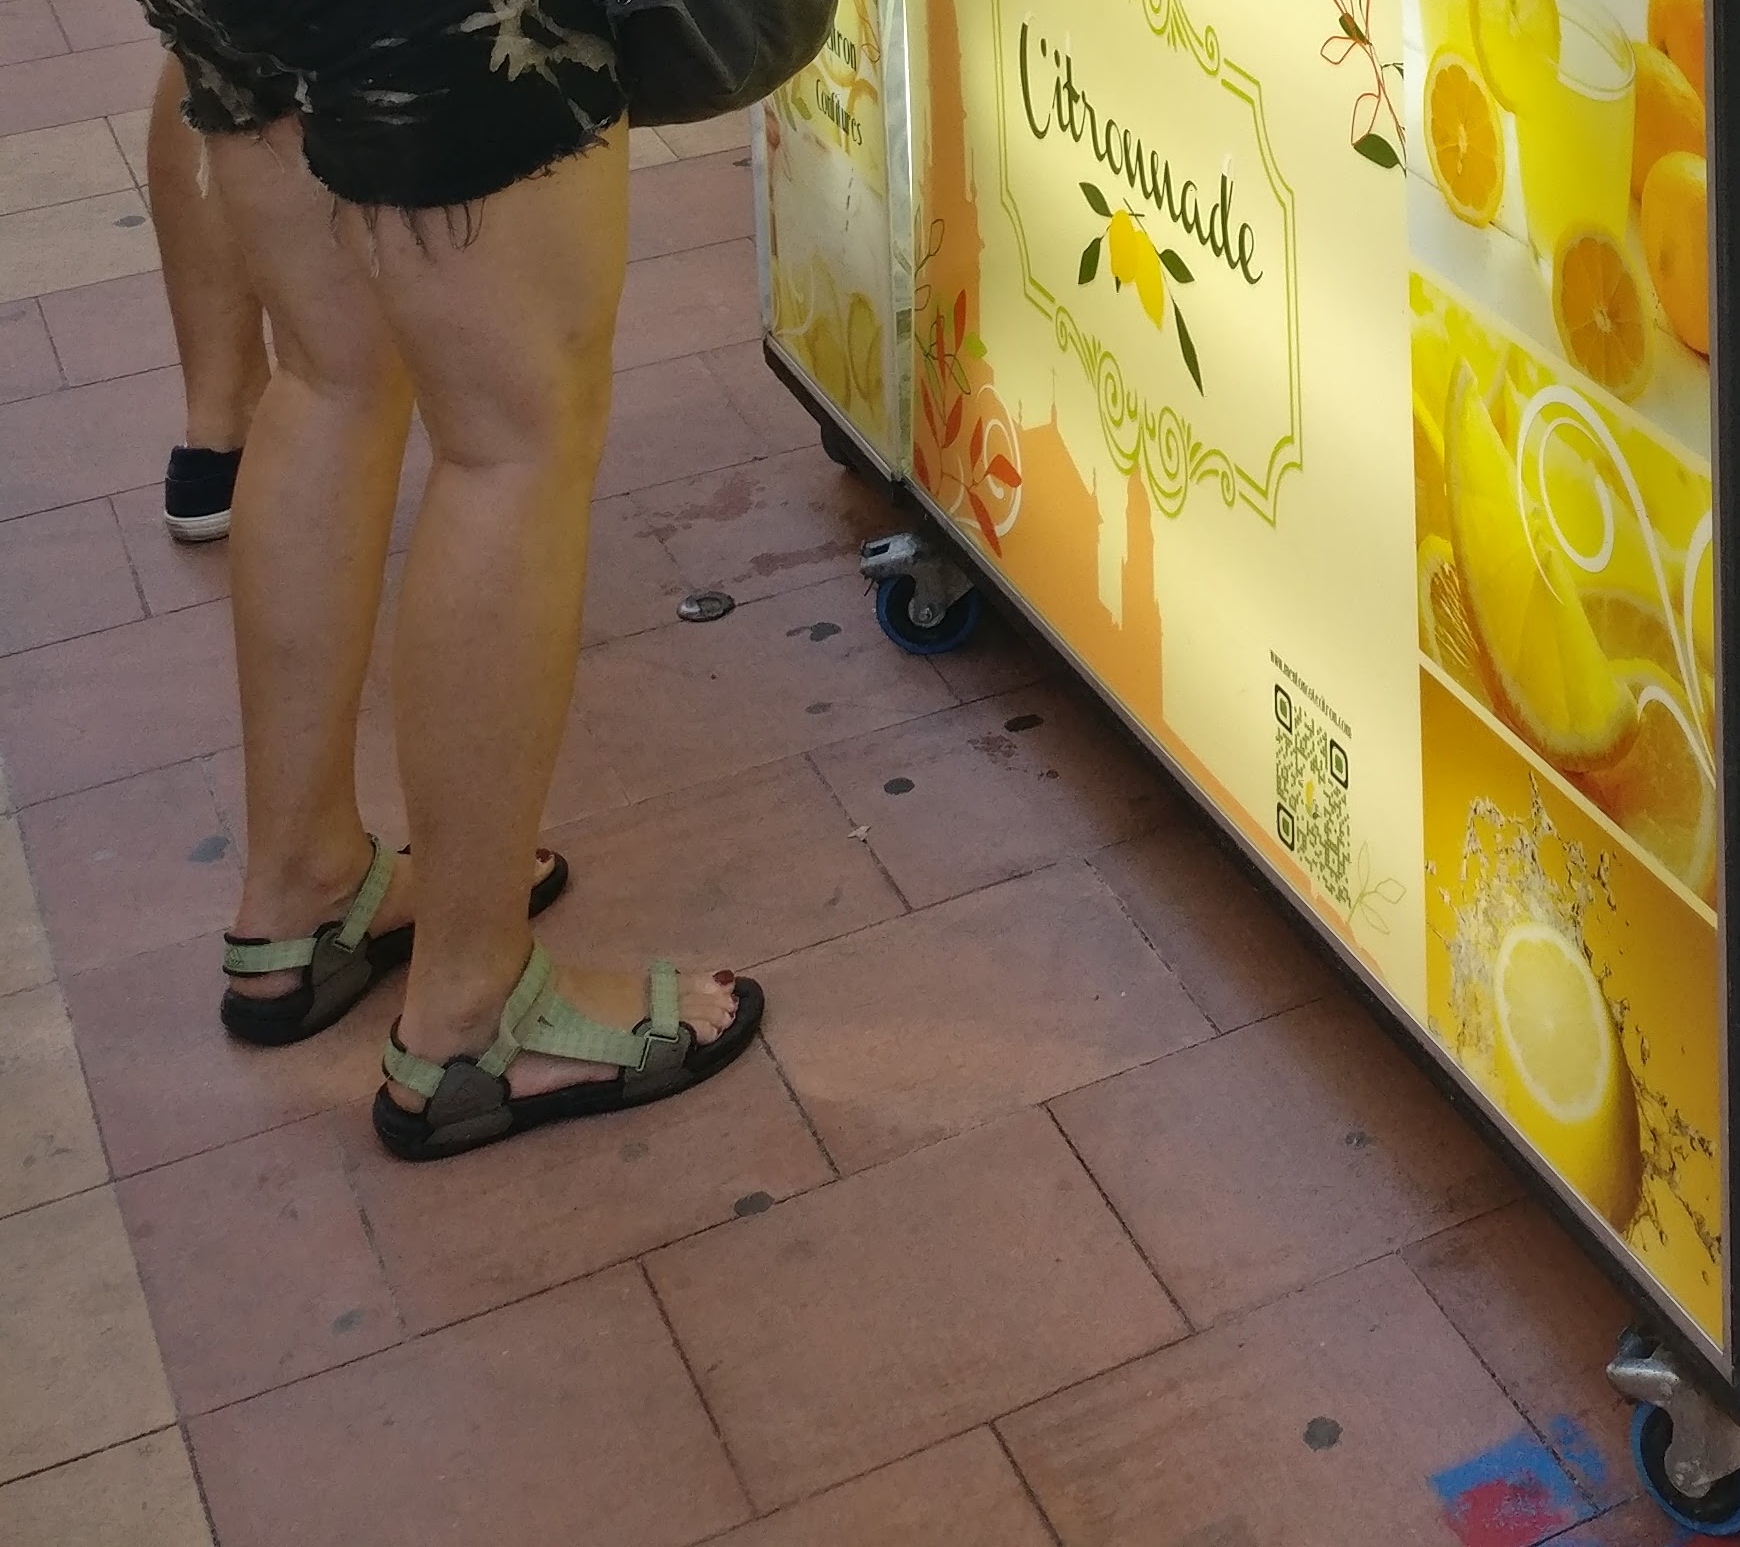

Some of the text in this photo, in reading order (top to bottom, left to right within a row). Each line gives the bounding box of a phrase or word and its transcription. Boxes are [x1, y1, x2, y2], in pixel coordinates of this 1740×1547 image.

[827, 27, 857, 72] itron
[815, 78, 863, 146] Confitures
[1019, 10, 1264, 285] Citronnade
